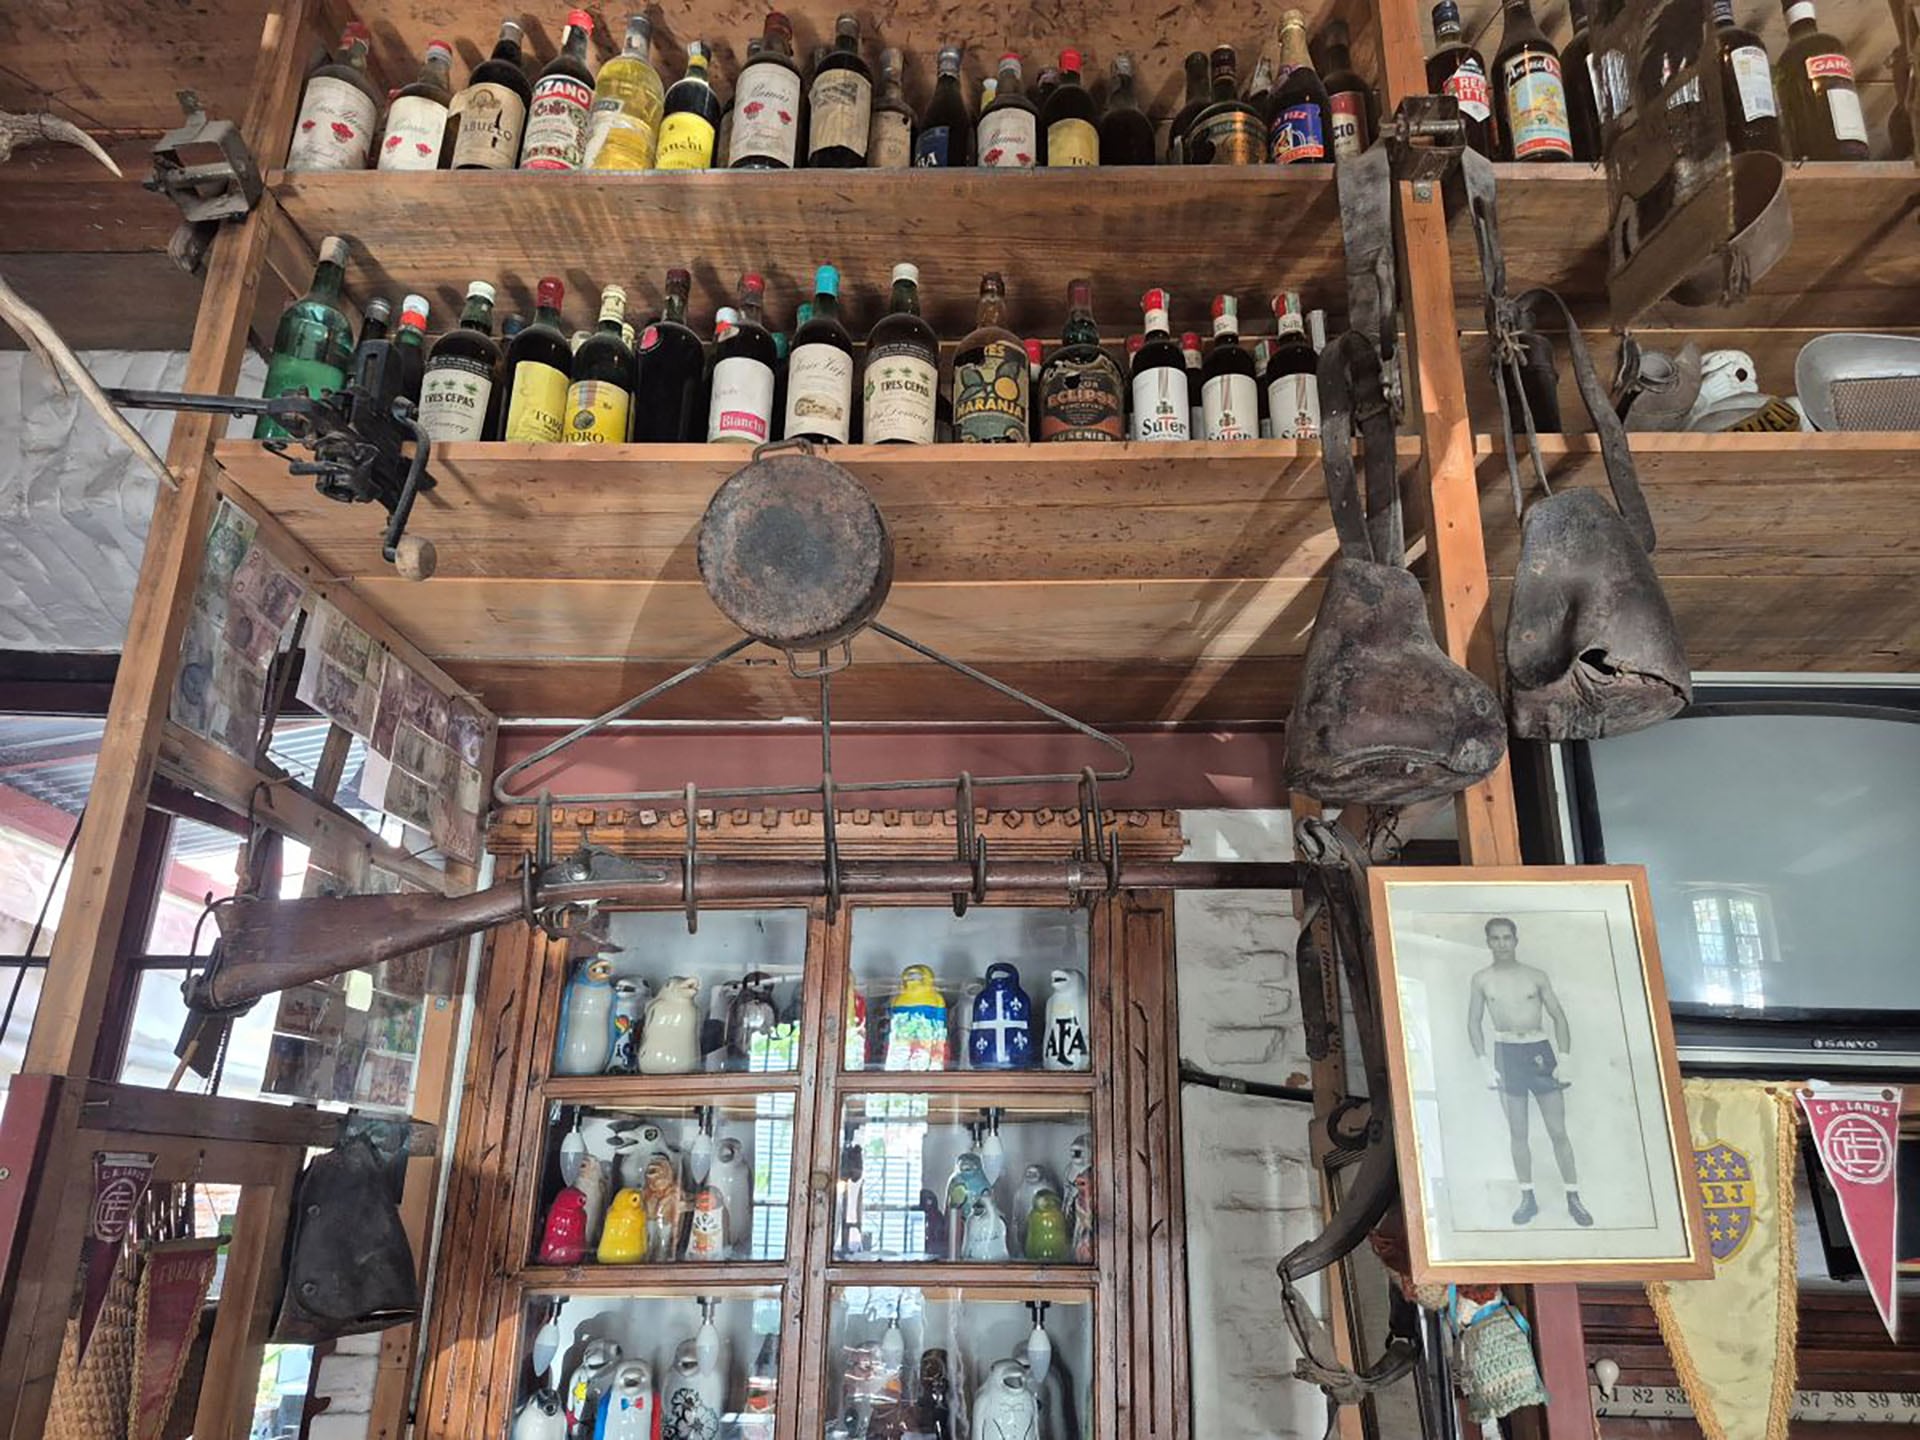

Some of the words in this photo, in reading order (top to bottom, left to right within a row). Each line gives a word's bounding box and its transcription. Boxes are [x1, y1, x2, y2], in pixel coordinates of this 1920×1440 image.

[881, 379, 903, 391] TRES
[424, 392, 443, 404] TRES
[445, 393, 475, 408] CEPAS
[956, 397, 1023, 419] NARANJA
[1824, 1039, 1878, 1049] SANYO
[1631, 1388, 1654, 1404] 82
[1664, 1388, 1687, 1404] 83
[1799, 1392, 1820, 1408] 87
[1832, 1392, 1857, 1408] 88
[1867, 1392, 1890, 1408] 89
